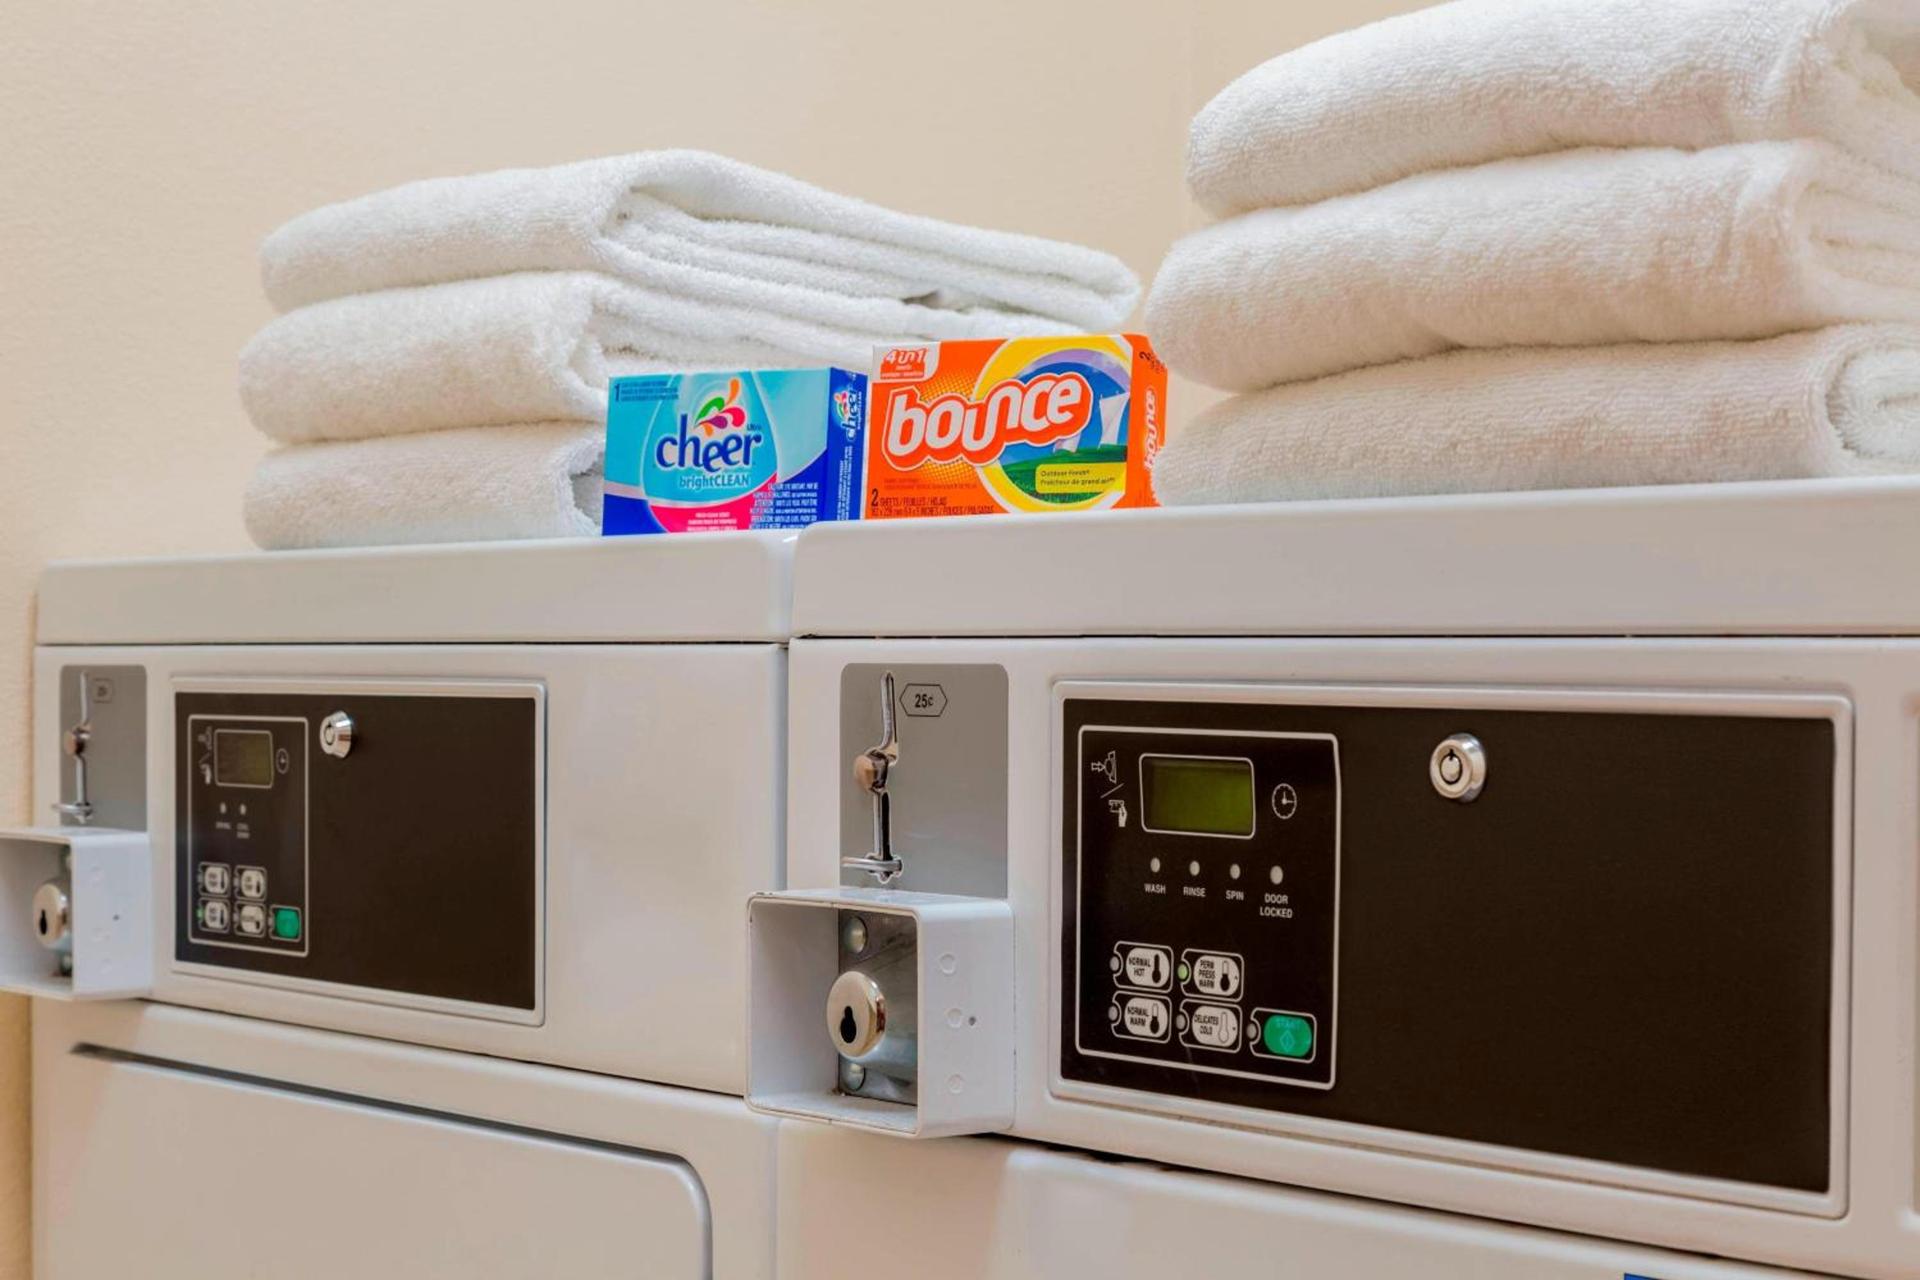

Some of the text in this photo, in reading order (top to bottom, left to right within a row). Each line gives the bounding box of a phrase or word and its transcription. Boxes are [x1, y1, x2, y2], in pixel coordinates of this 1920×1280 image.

[885, 377, 1082, 456] bounce
[656, 413, 763, 473] cheer
[680, 474, 749, 490] brightCLEAN
[871, 488, 879, 507] 2
[1144, 883, 1166, 895] WASH
[1183, 886, 1206, 898] RINSE
[1225, 890, 1244, 901] SPIN
[1264, 893, 1289, 905] DOOR
[1259, 906, 1293, 919] LOCKED
[1128, 957, 1151, 968] NORMAL
[1200, 960, 1215, 969] PERM
[1134, 968, 1145, 977] HOT
[1199, 969, 1216, 979] PRESS
[1127, 1006, 1149, 1018] NORMAL
[1130, 1017, 1146, 1027] WARM
